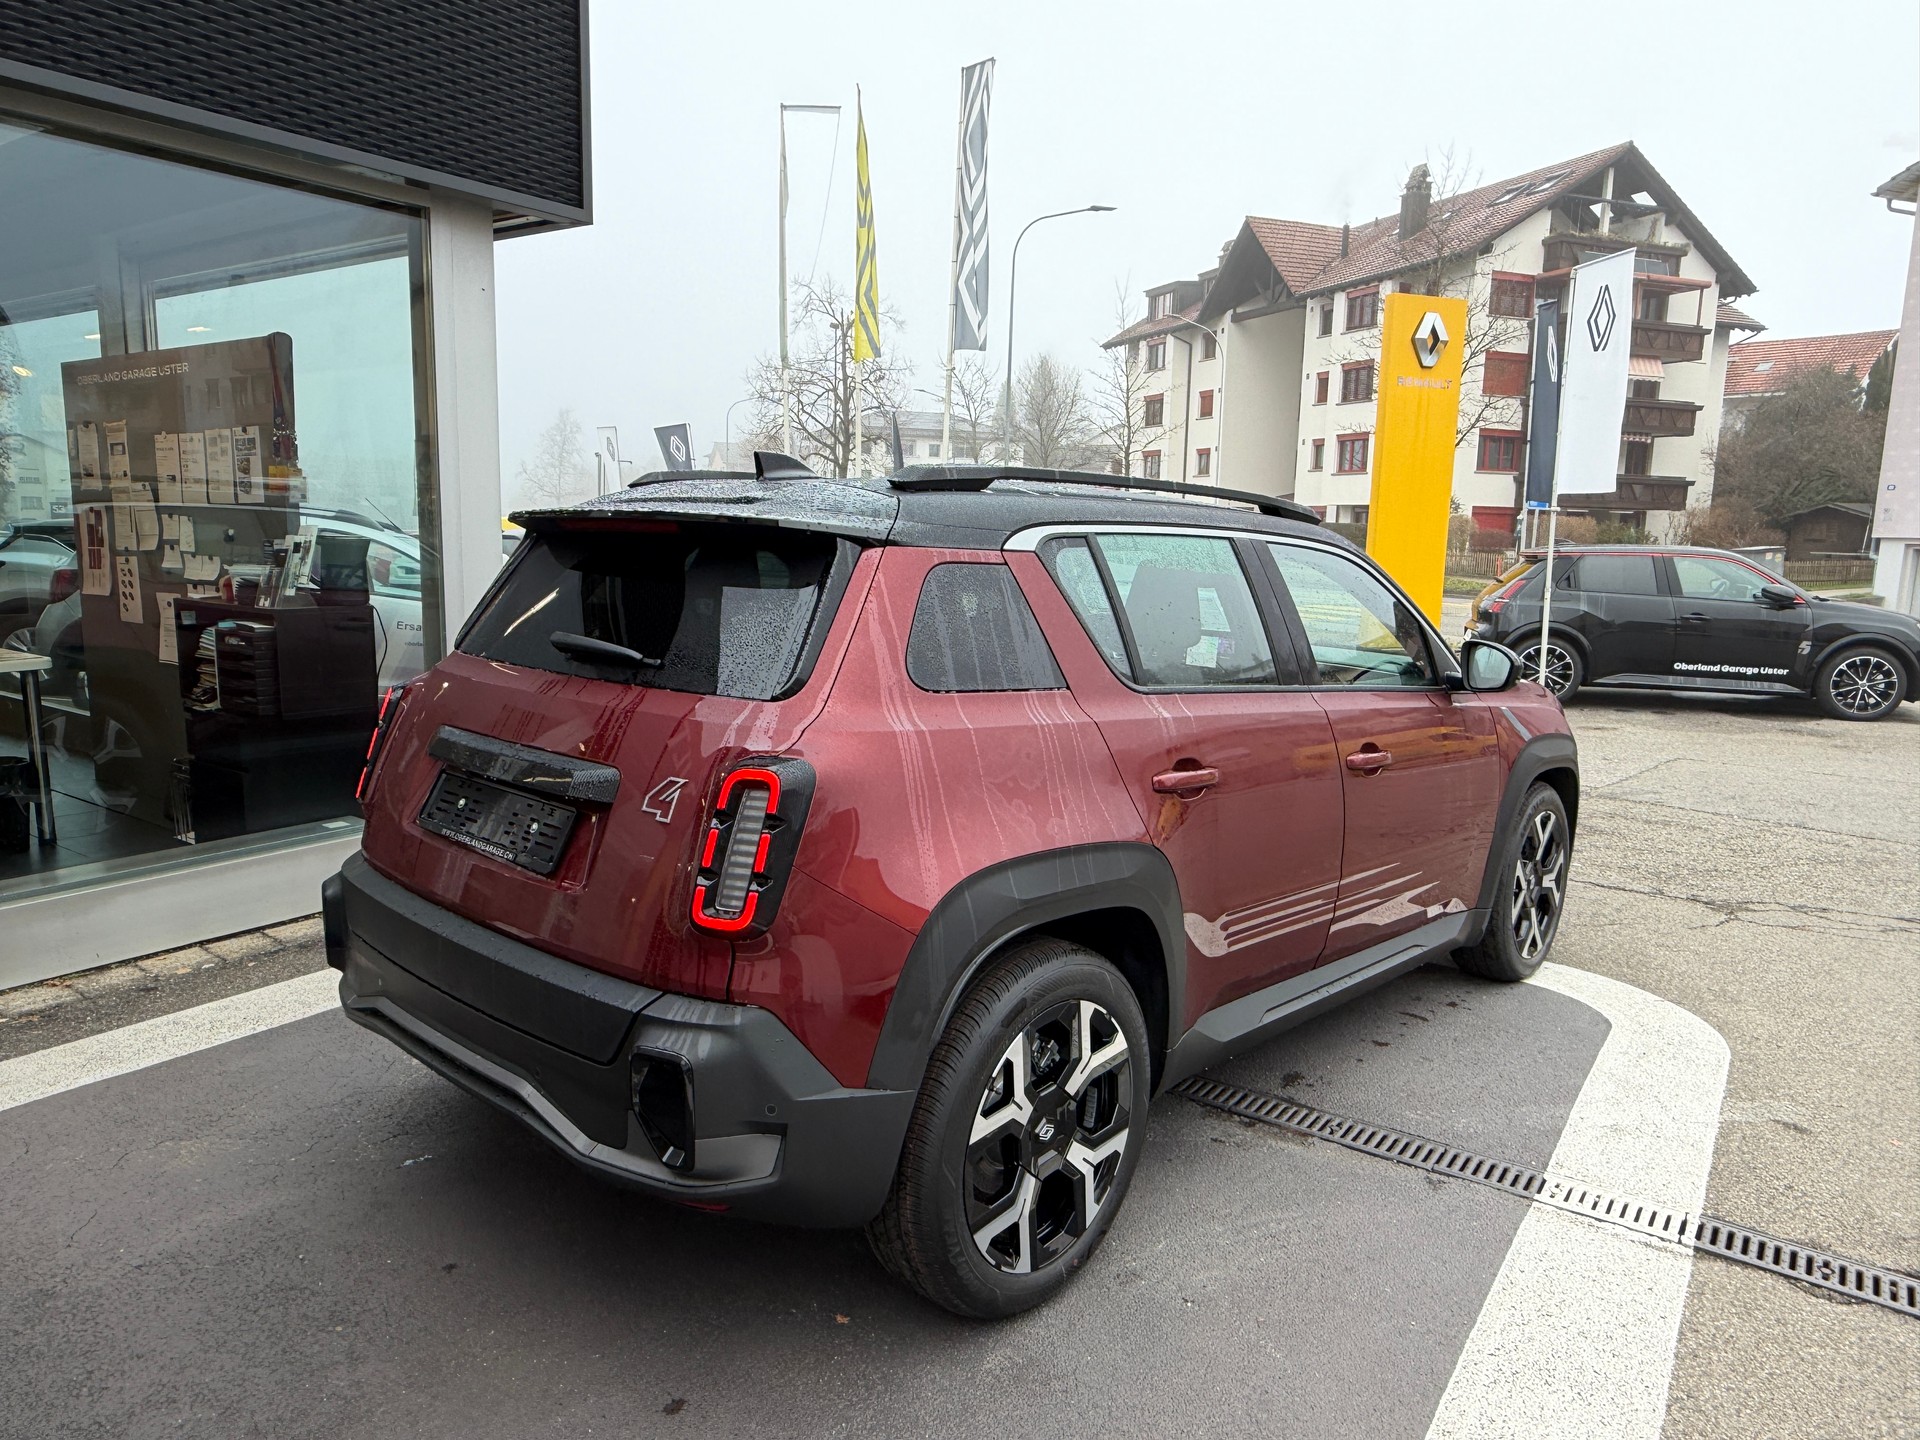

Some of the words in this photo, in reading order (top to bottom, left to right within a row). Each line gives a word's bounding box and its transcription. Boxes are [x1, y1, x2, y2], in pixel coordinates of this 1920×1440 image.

[77, 371, 121, 385] OBERLAND
[121, 366, 158, 380] GARAGE
[158, 362, 190, 376] USTER
[1397, 375, 1453, 389] RENAULT
[1673, 662, 1721, 672] Oberland
[1721, 664, 1760, 675] Garage
[1760, 666, 1790, 676] Uster
